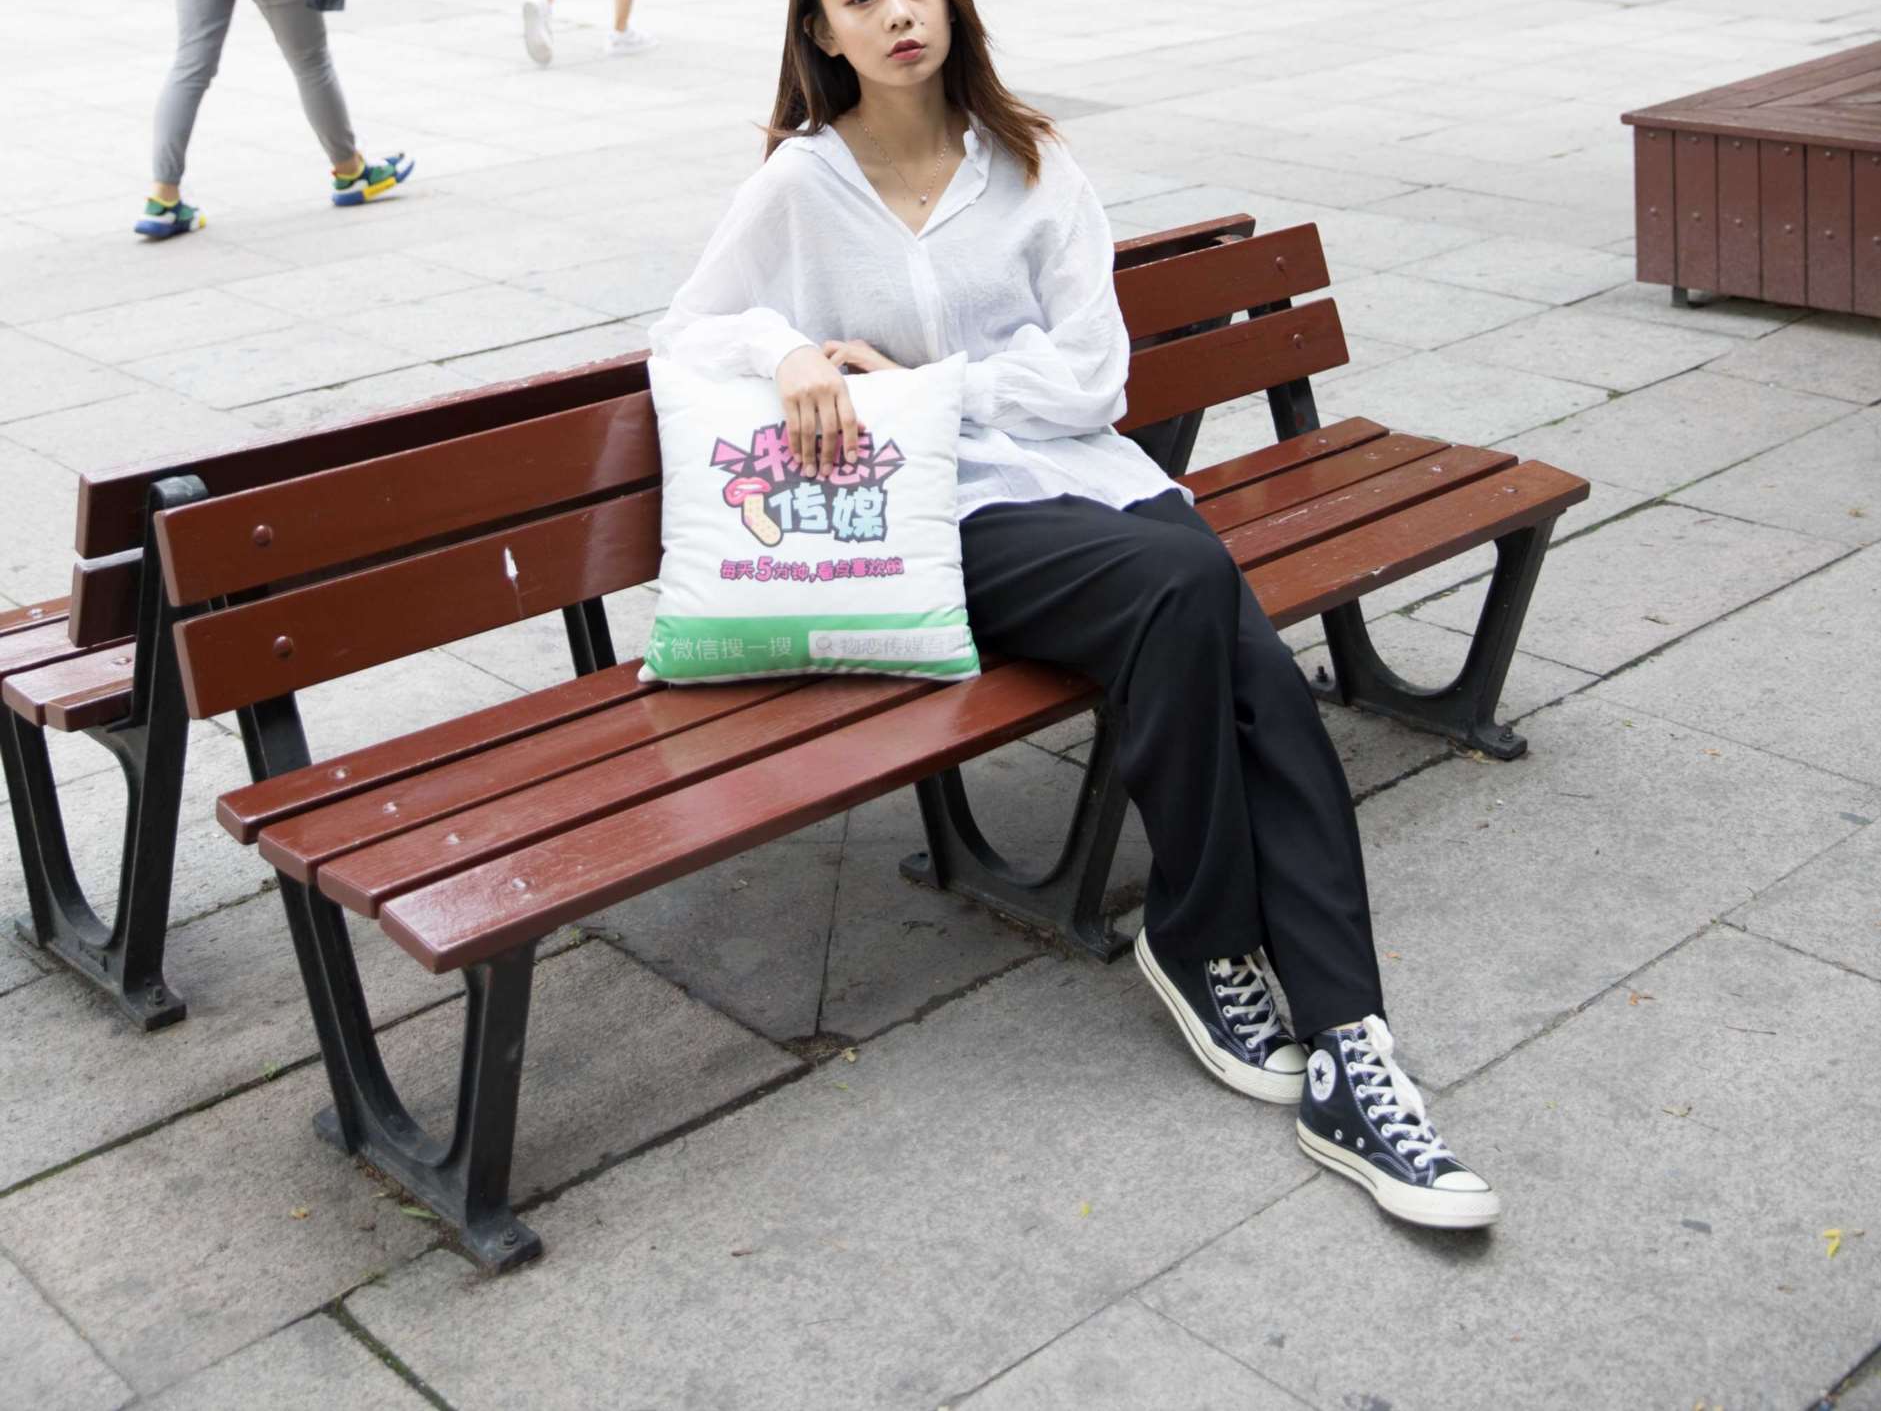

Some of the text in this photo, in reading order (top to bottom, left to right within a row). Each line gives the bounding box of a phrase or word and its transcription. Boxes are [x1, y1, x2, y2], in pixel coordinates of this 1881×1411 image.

[768, 481, 885, 540] 传媒
[670, 636, 793, 661] 微信搜一搜
